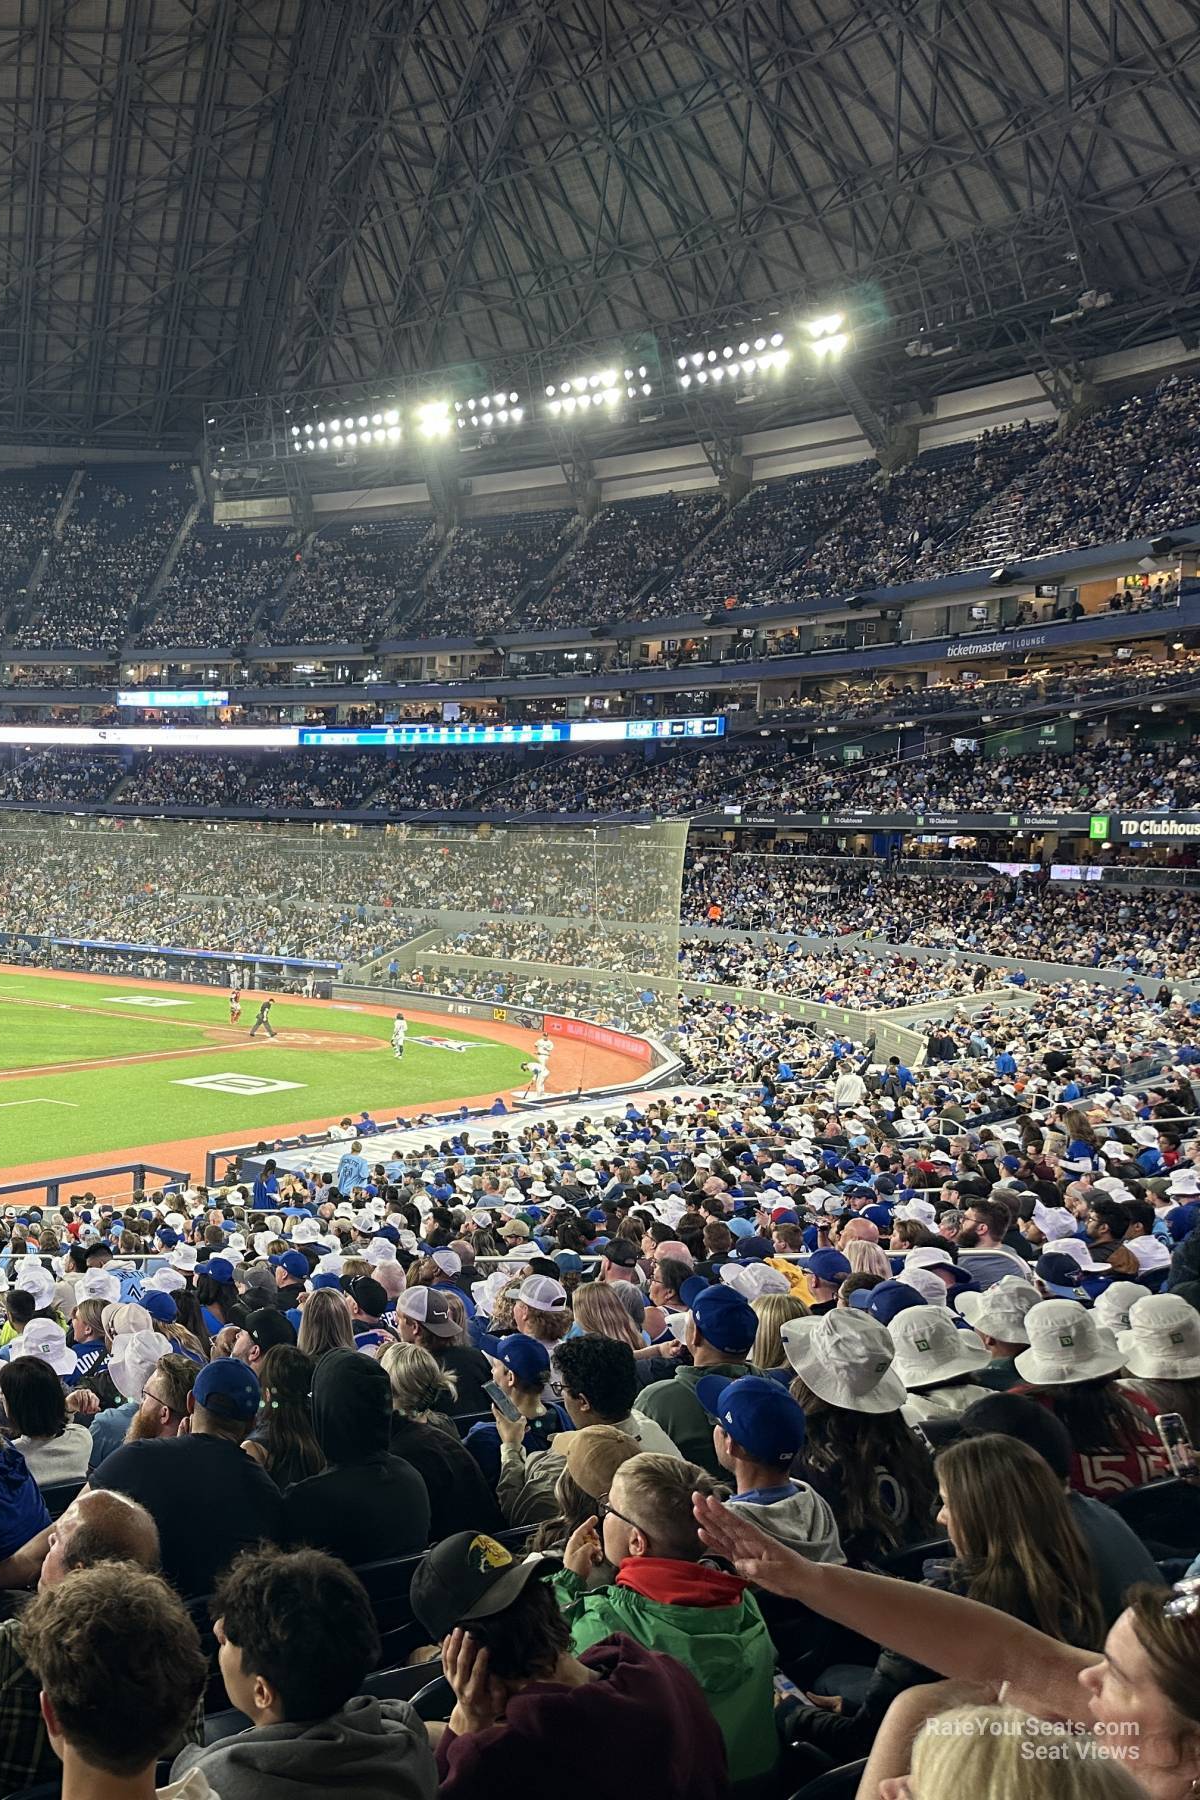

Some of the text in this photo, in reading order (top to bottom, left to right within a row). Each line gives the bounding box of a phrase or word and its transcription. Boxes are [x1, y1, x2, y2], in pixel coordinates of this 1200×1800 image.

[947, 636, 1046, 657] ticketmaster LOUNGE
[1120, 820, 1138, 835] TD
[457, 1005, 472, 1014] BET
